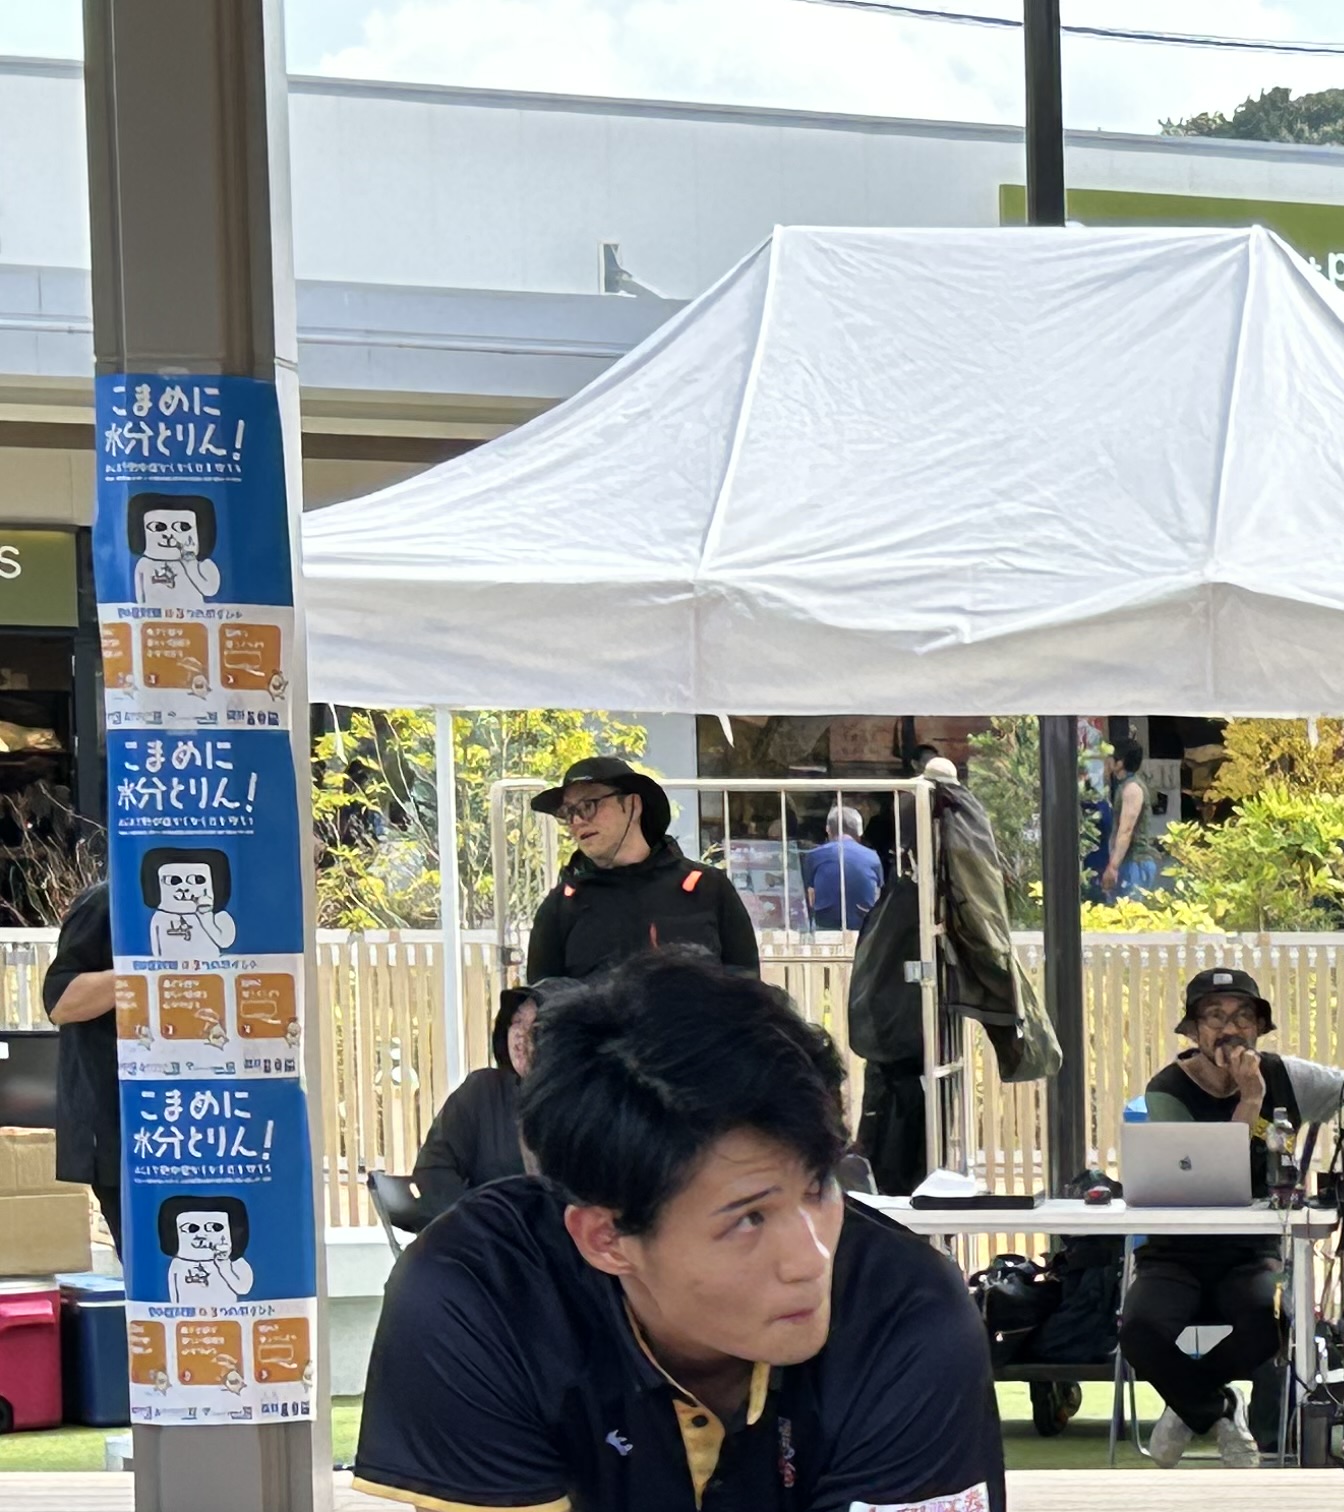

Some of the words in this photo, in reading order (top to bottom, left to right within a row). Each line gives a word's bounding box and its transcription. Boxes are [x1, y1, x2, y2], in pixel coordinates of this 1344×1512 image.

[112, 384, 221, 416] こまめに
[124, 740, 233, 772] こまめに
[140, 1089, 252, 1122] こまめに
